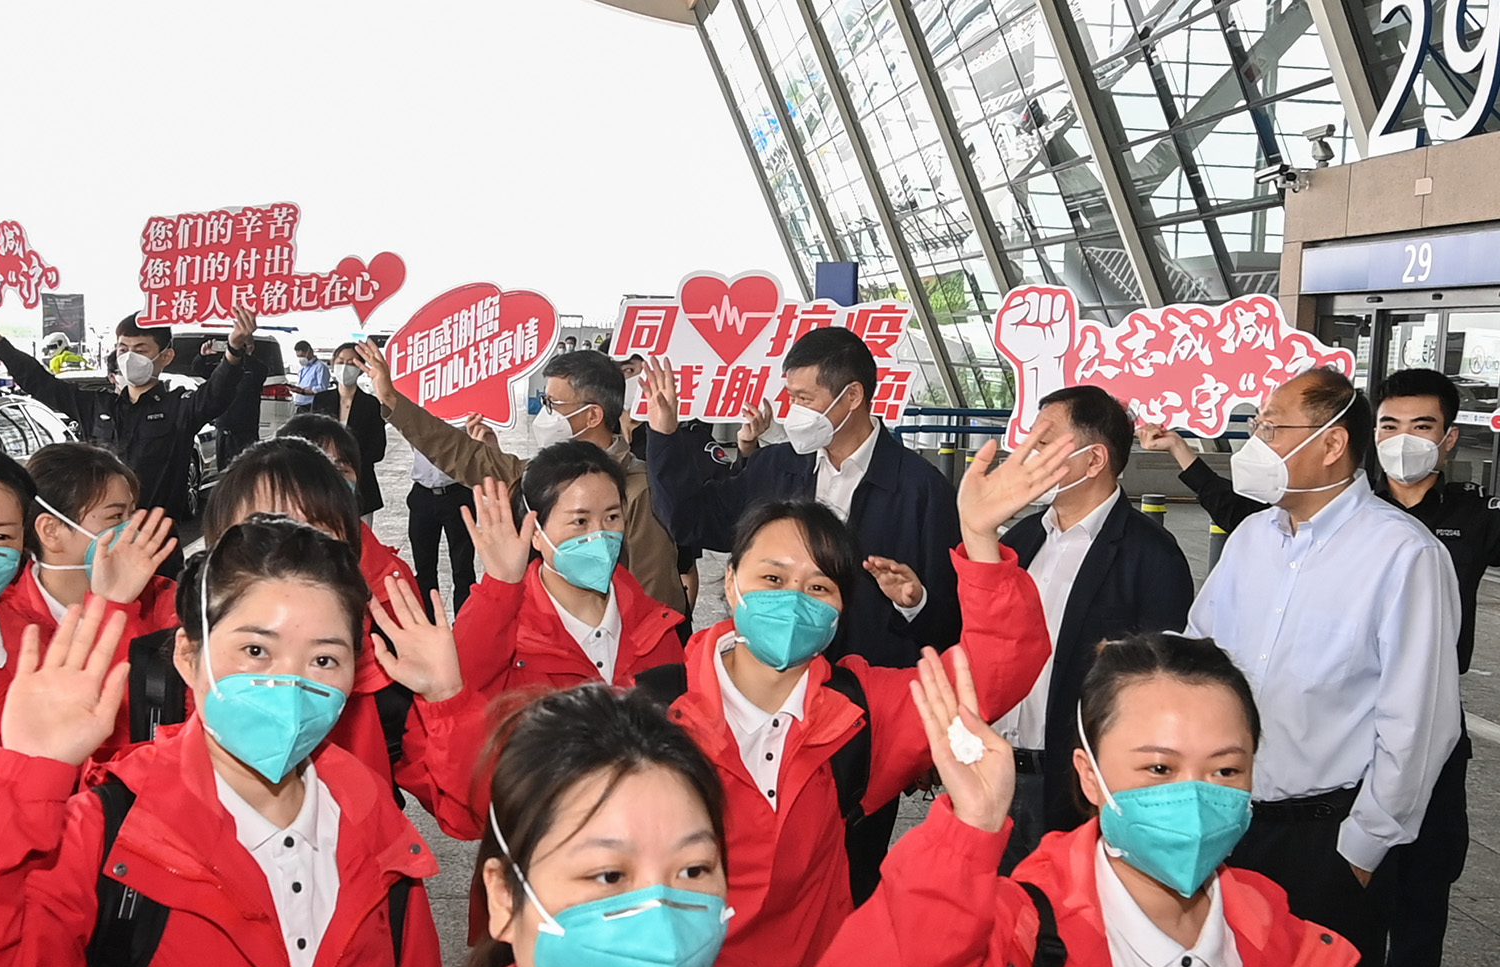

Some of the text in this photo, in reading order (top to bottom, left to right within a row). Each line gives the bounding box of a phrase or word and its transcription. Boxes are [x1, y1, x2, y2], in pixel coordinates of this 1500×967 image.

[1368, 0, 1500, 158] 29
[144, 206, 295, 252] 您们的辛苦
[143, 245, 291, 289] 您们的付出
[1402, 242, 1433, 284] 29
[143, 271, 380, 323] 上海人民铭记在心
[390, 295, 501, 382] 上海感谢您
[613, 303, 909, 358] 同 抗疫
[1074, 303, 1276, 384] 众志成城
[418, 316, 540, 408] 同心战疫情
